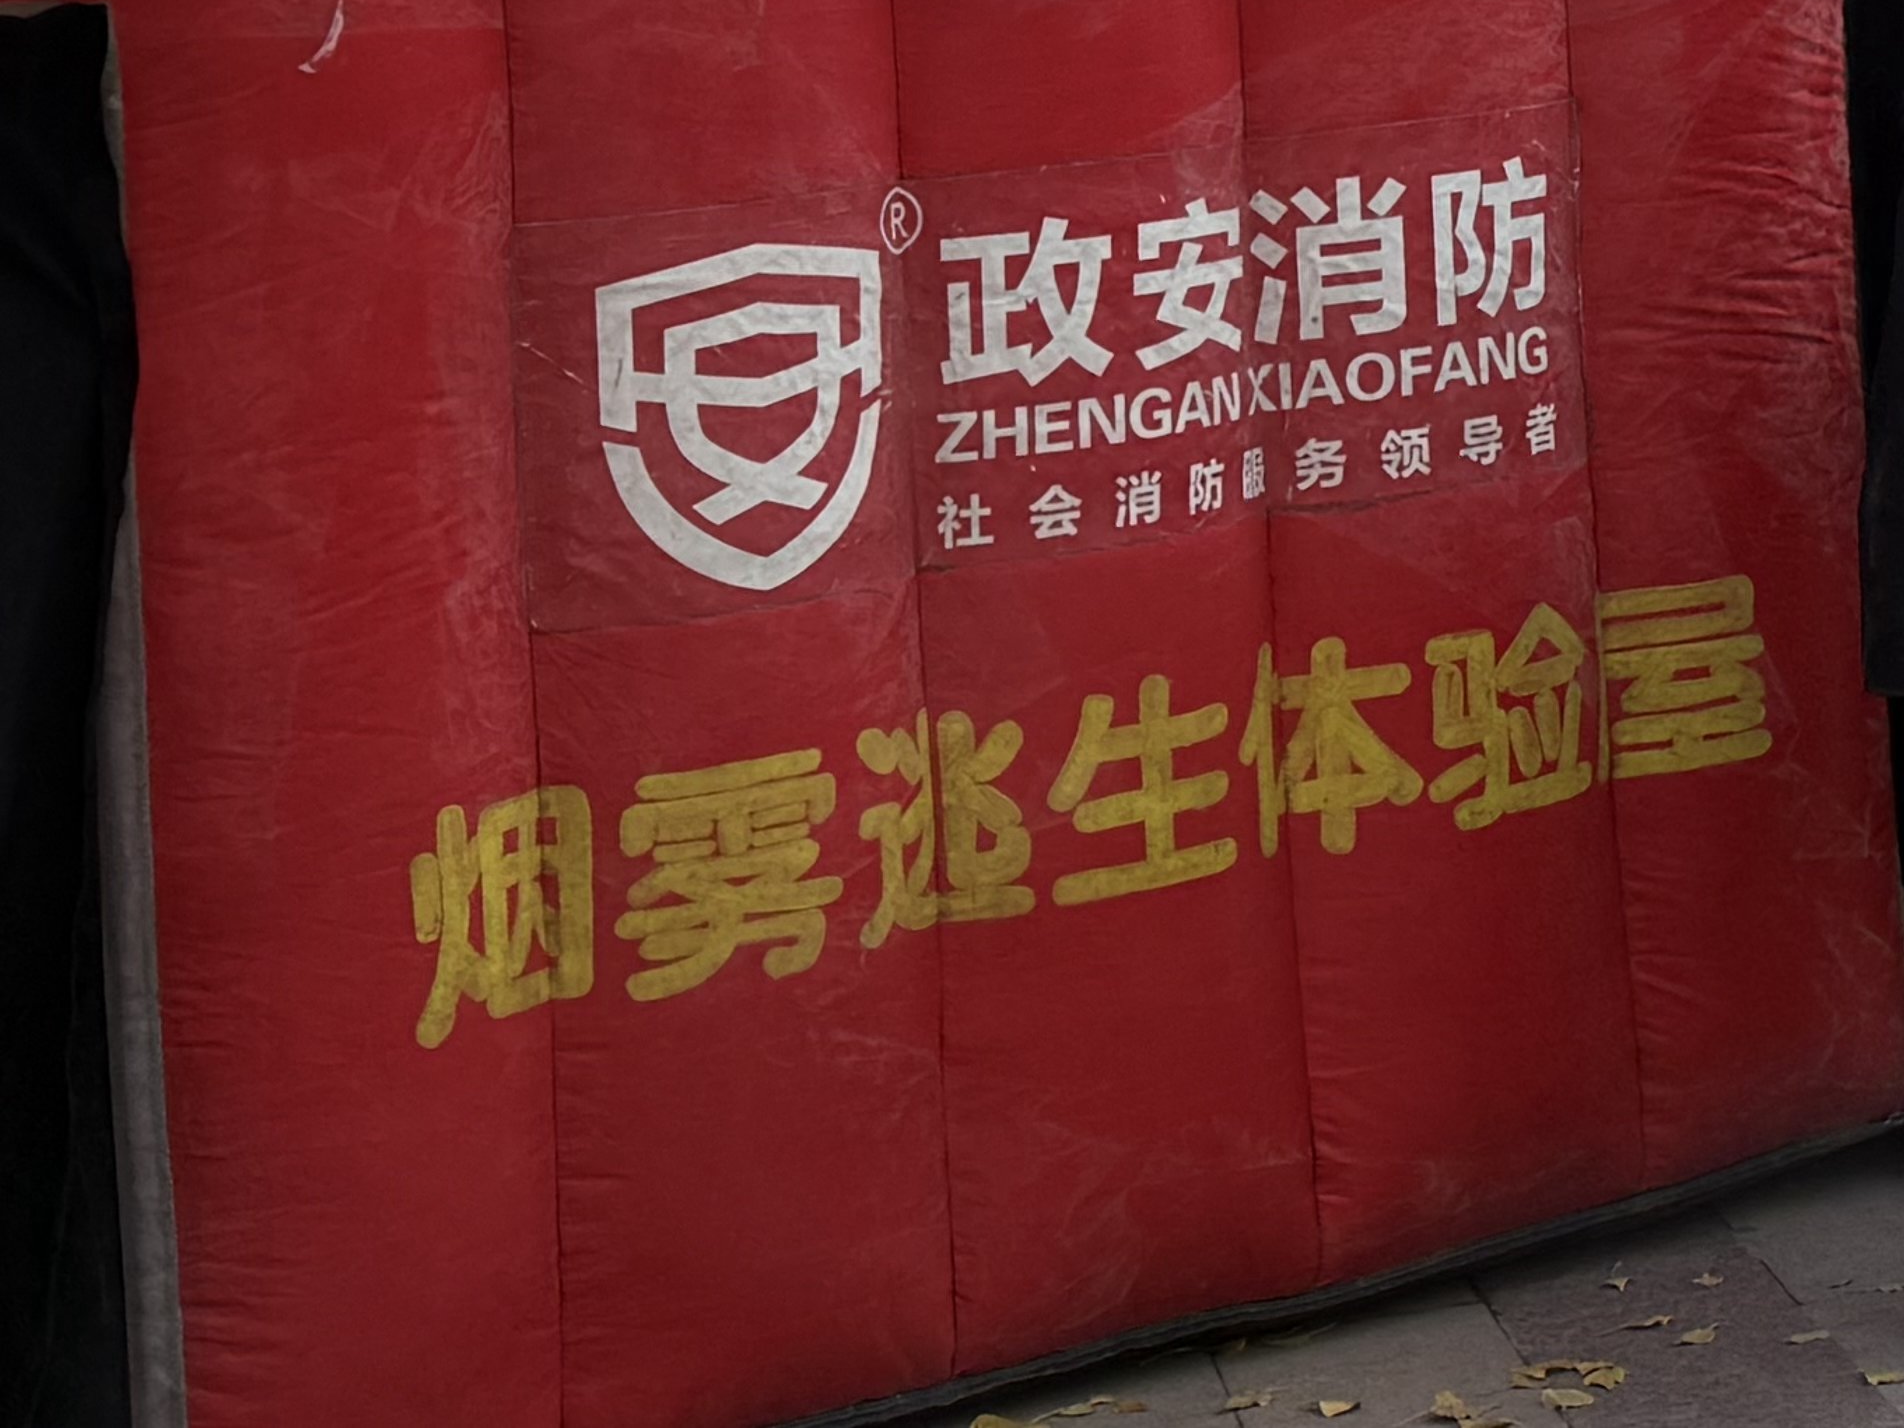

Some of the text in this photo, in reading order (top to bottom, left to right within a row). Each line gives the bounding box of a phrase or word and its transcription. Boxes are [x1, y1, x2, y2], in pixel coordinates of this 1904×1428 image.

[938, 154, 1549, 389] 政安消防
[935, 325, 1550, 464] ZHENGANXIAOFANG
[935, 399, 1558, 551] 社会消防服务领导者
[410, 573, 1774, 1049] 烟雾逃生体验屋
